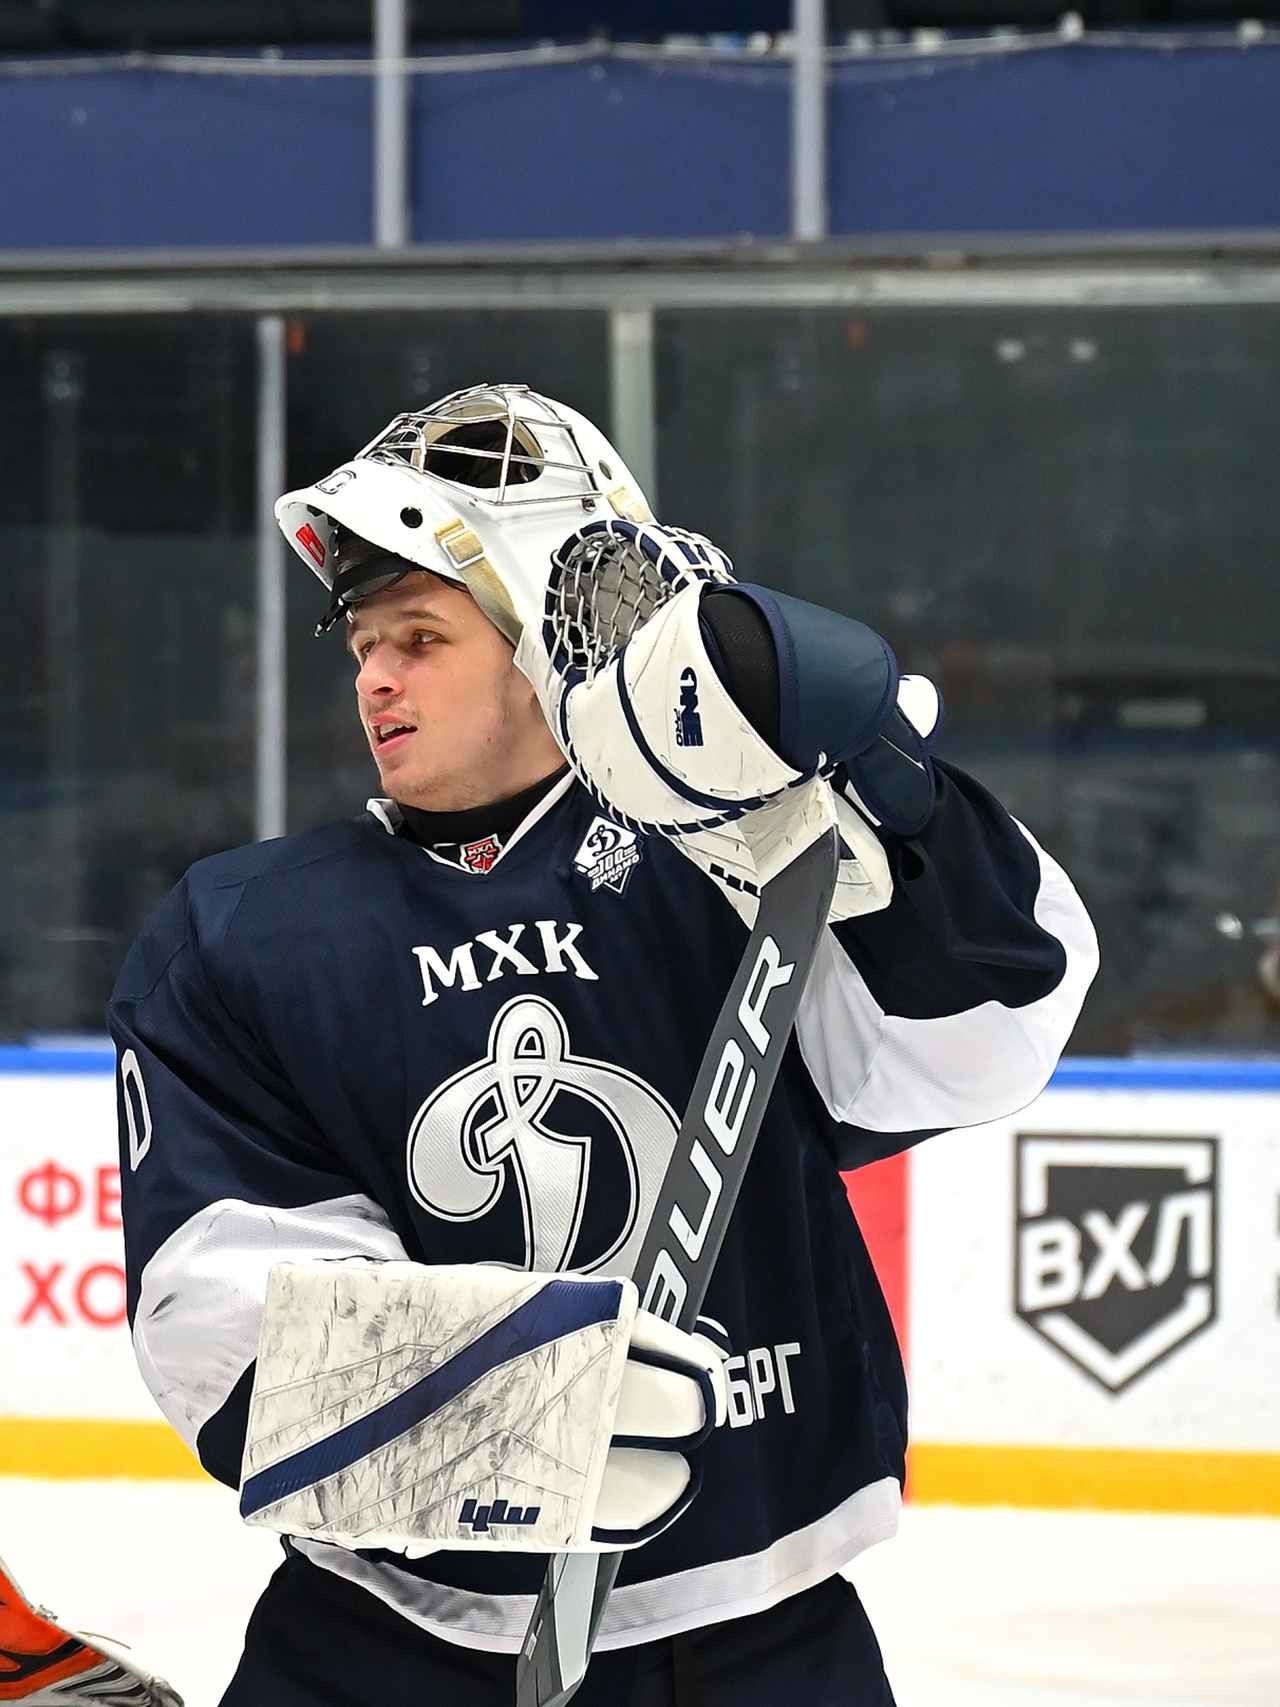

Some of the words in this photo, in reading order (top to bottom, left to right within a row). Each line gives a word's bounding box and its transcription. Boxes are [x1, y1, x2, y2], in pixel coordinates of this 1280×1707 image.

[411, 919, 600, 1007] МХК
[1018, 1188, 1214, 1313] ВХЛ
[723, 1341, 801, 1430] БРГ
